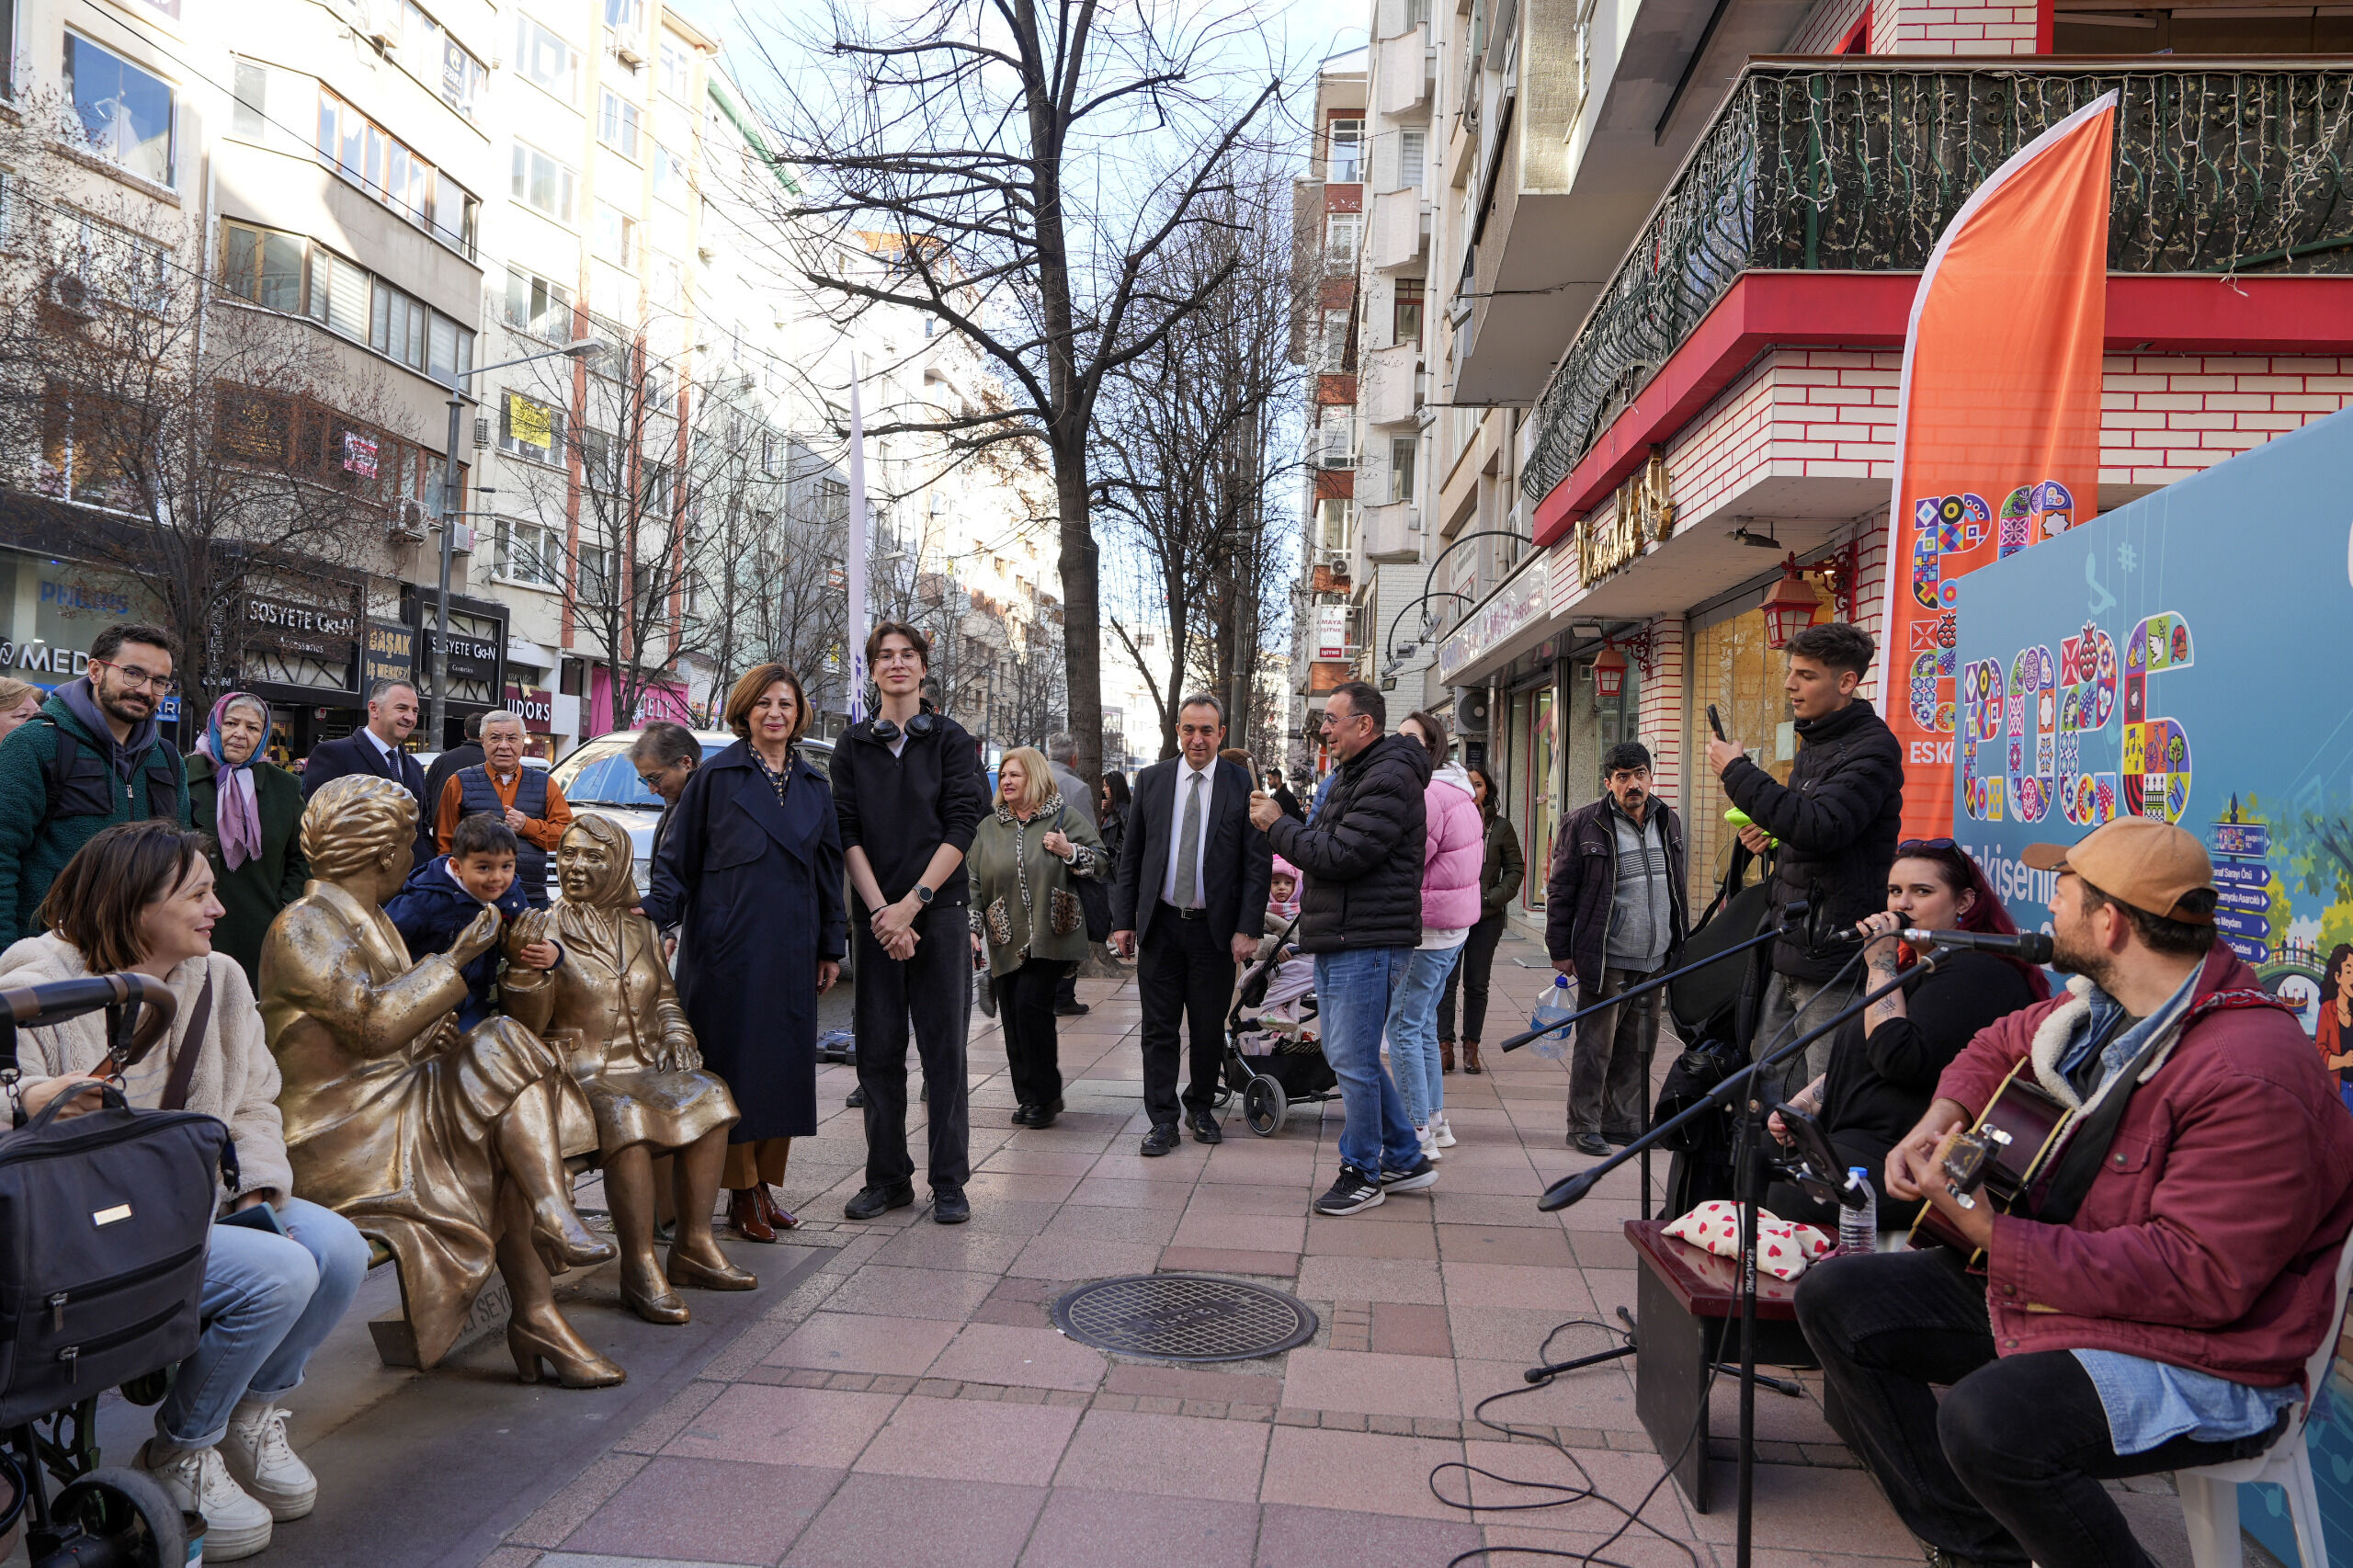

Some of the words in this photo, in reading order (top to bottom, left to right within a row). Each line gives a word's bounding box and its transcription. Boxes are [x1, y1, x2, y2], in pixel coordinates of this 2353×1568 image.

[249, 600, 313, 630] SOSYETE
[369, 631, 412, 658] BAŞAK
[432, 636, 470, 656] SSYETE
[505, 699, 551, 722] UDORS
[1963, 610, 2194, 827] 2026
